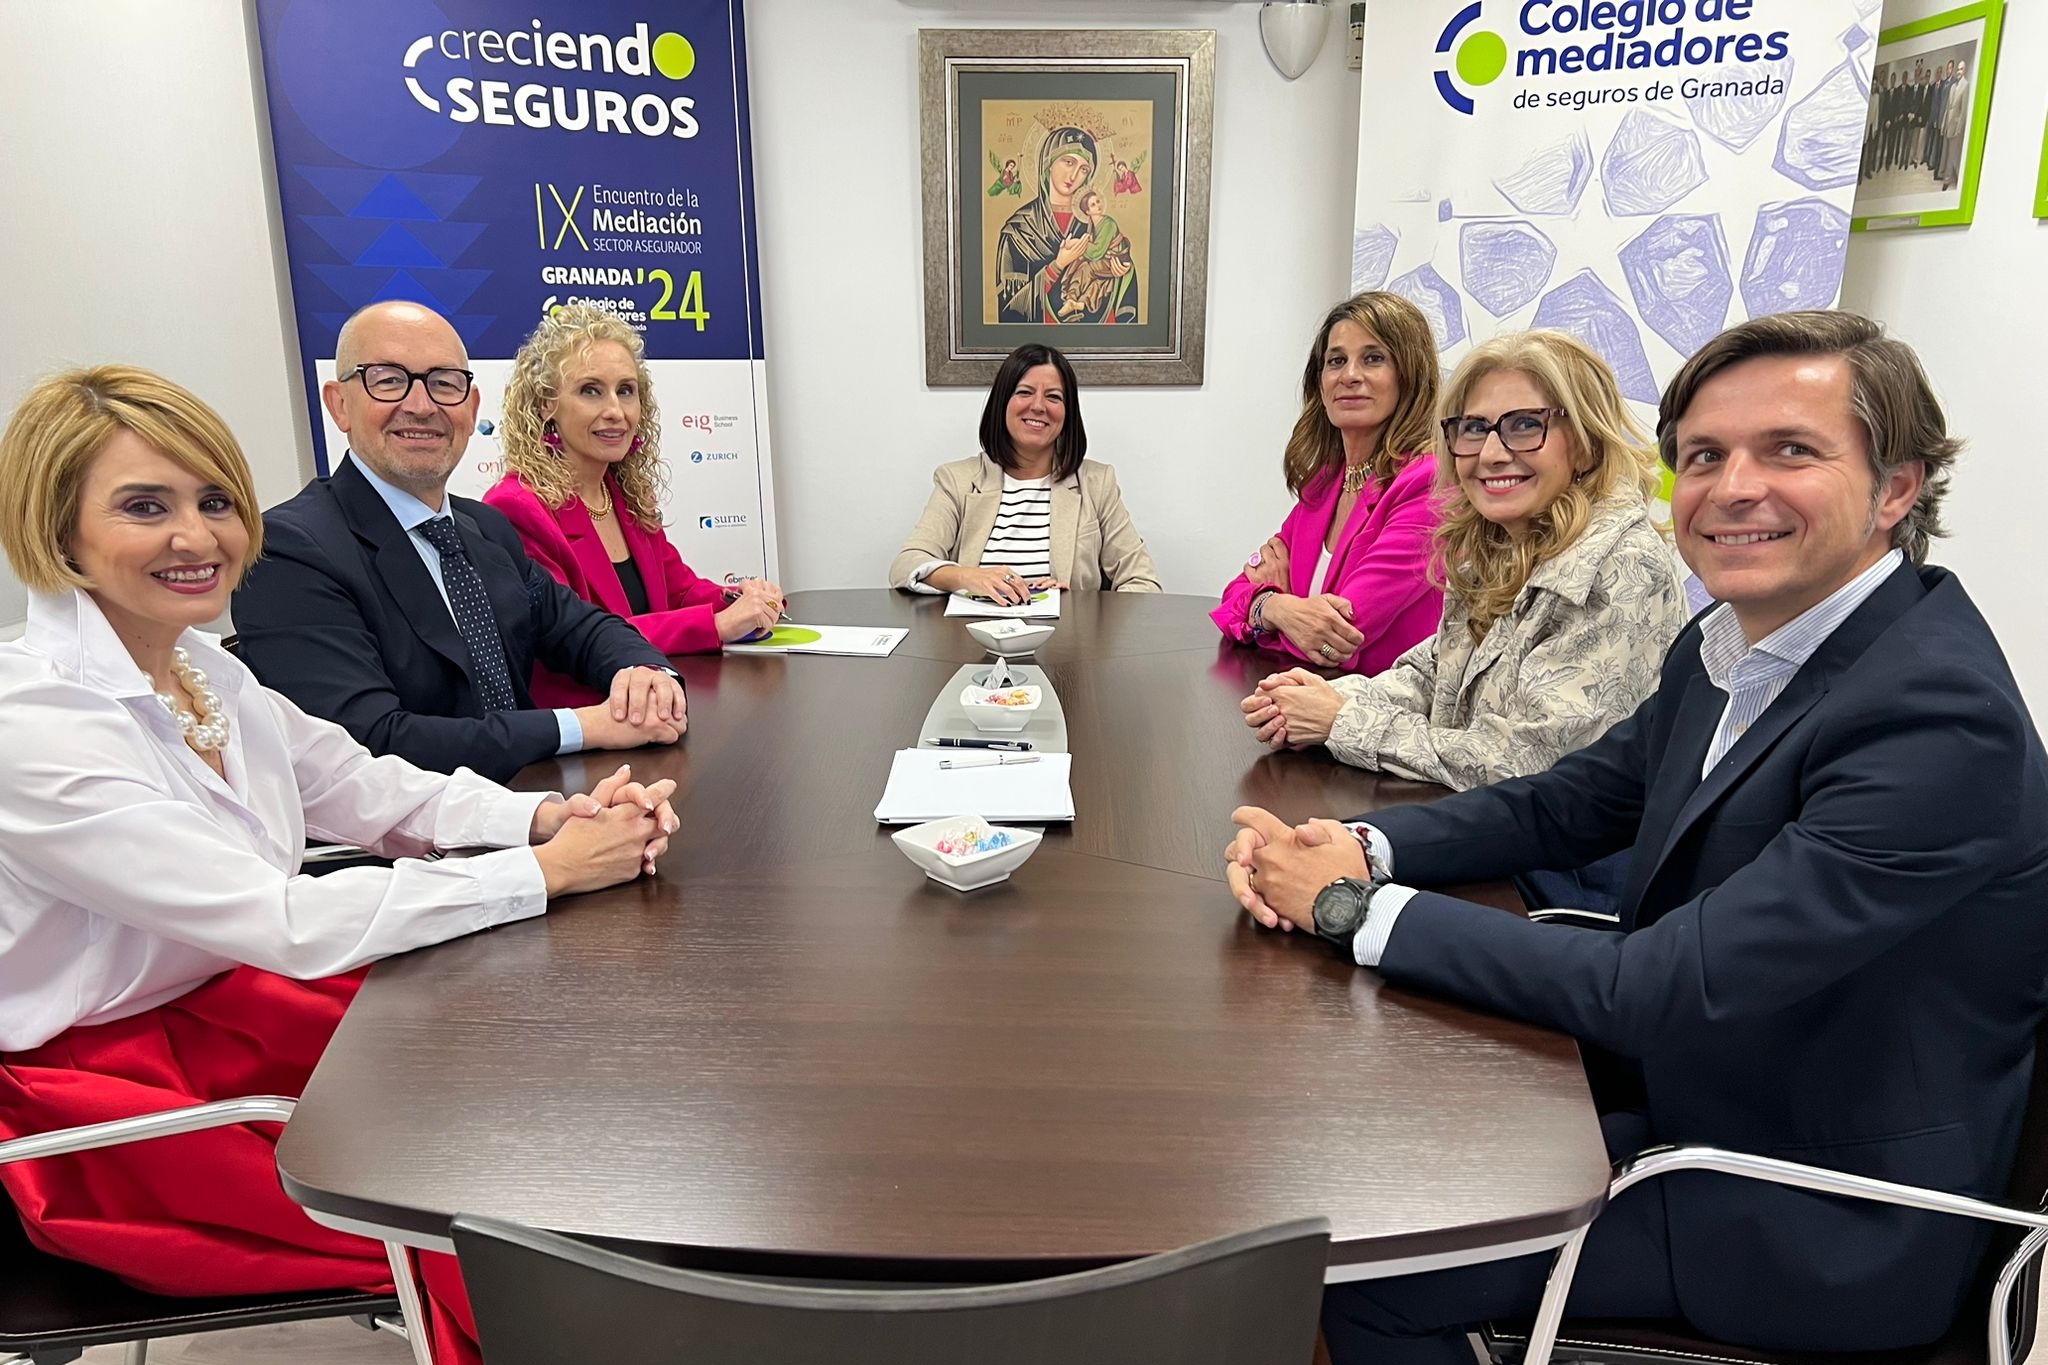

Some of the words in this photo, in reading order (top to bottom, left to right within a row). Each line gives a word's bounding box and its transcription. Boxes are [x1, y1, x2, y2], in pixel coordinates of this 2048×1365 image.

[1519, 0, 1687, 39] Colegio
[1695, 0, 1754, 22] de
[1516, 28, 1790, 77] mediadores
[1513, 89, 1540, 109] de
[1546, 86, 1638, 110] seguros
[1645, 81, 1674, 100] de
[1681, 74, 1784, 99] Granada
[446, 77, 699, 139] SEGUROS
[593, 184, 663, 206] Encuentro
[667, 188, 683, 207] de
[686, 188, 699, 208] la
[535, 183, 589, 251] IX
[592, 208, 702, 235] Mediación
[592, 238, 633, 252] SECTOR
[634, 240, 702, 254] ASEGURADOR
[541, 266, 634, 286] GRANADA
[618, 297, 635, 310] de
[682, 415, 713, 434] eig
[706, 452, 738, 461] ZURICH
[714, 514, 747, 524] surne
